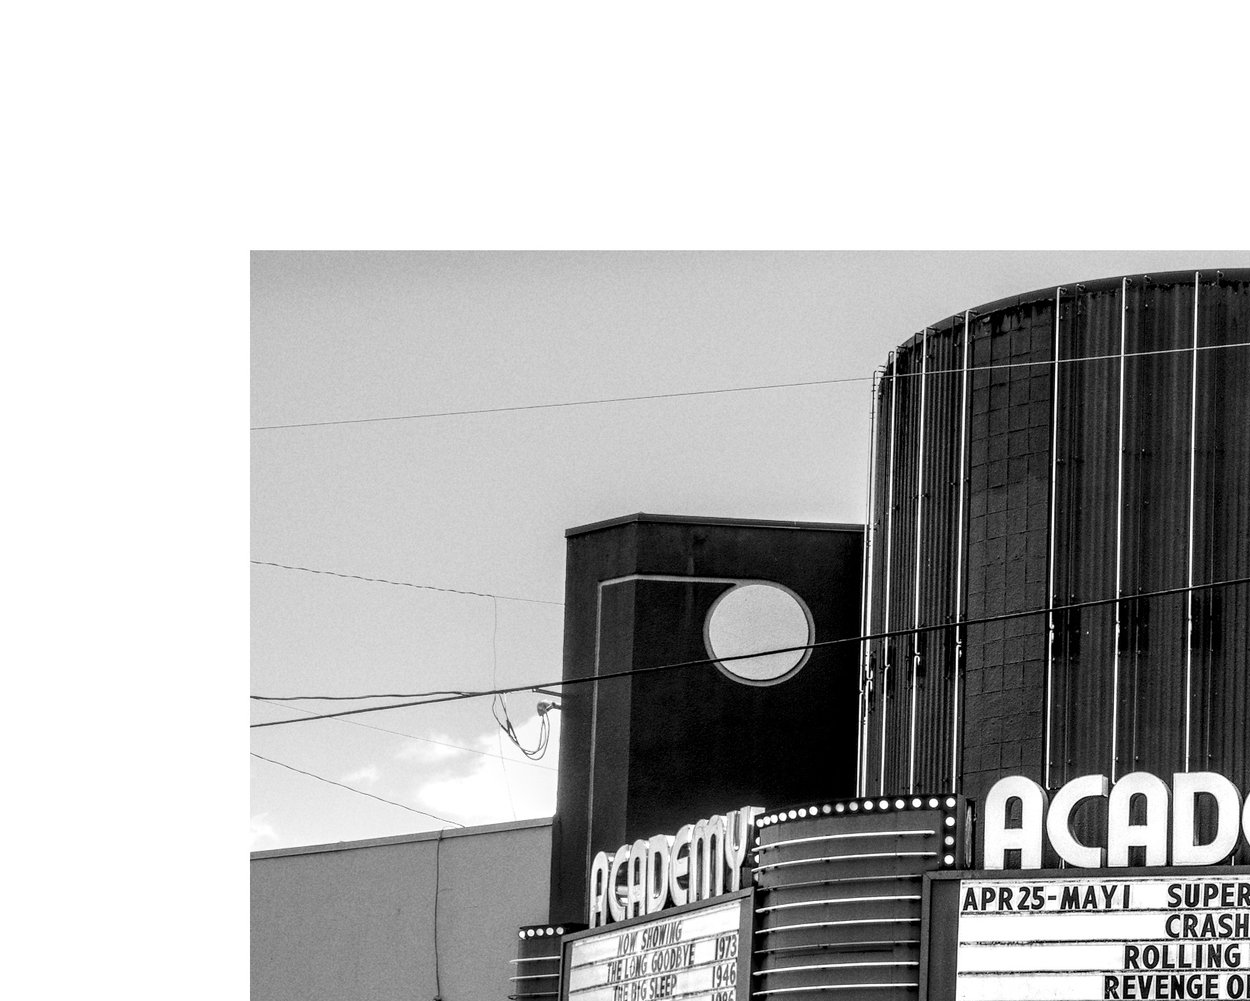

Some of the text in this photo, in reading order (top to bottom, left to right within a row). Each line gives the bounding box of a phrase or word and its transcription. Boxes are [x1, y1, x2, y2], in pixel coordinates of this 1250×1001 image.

[589, 805, 766, 929] ACADEMY
[618, 920, 683, 957] NOW SHOWING
[1165, 913, 1250, 939] CRASH
[607, 934, 738, 984] THE LONG GOODBYE 1973
[1124, 943, 1242, 970] ROLLING
[649, 973, 678, 998] SLEEP
[711, 962, 736, 989] 1946
[1103, 974, 1219, 1000] REVENGE
